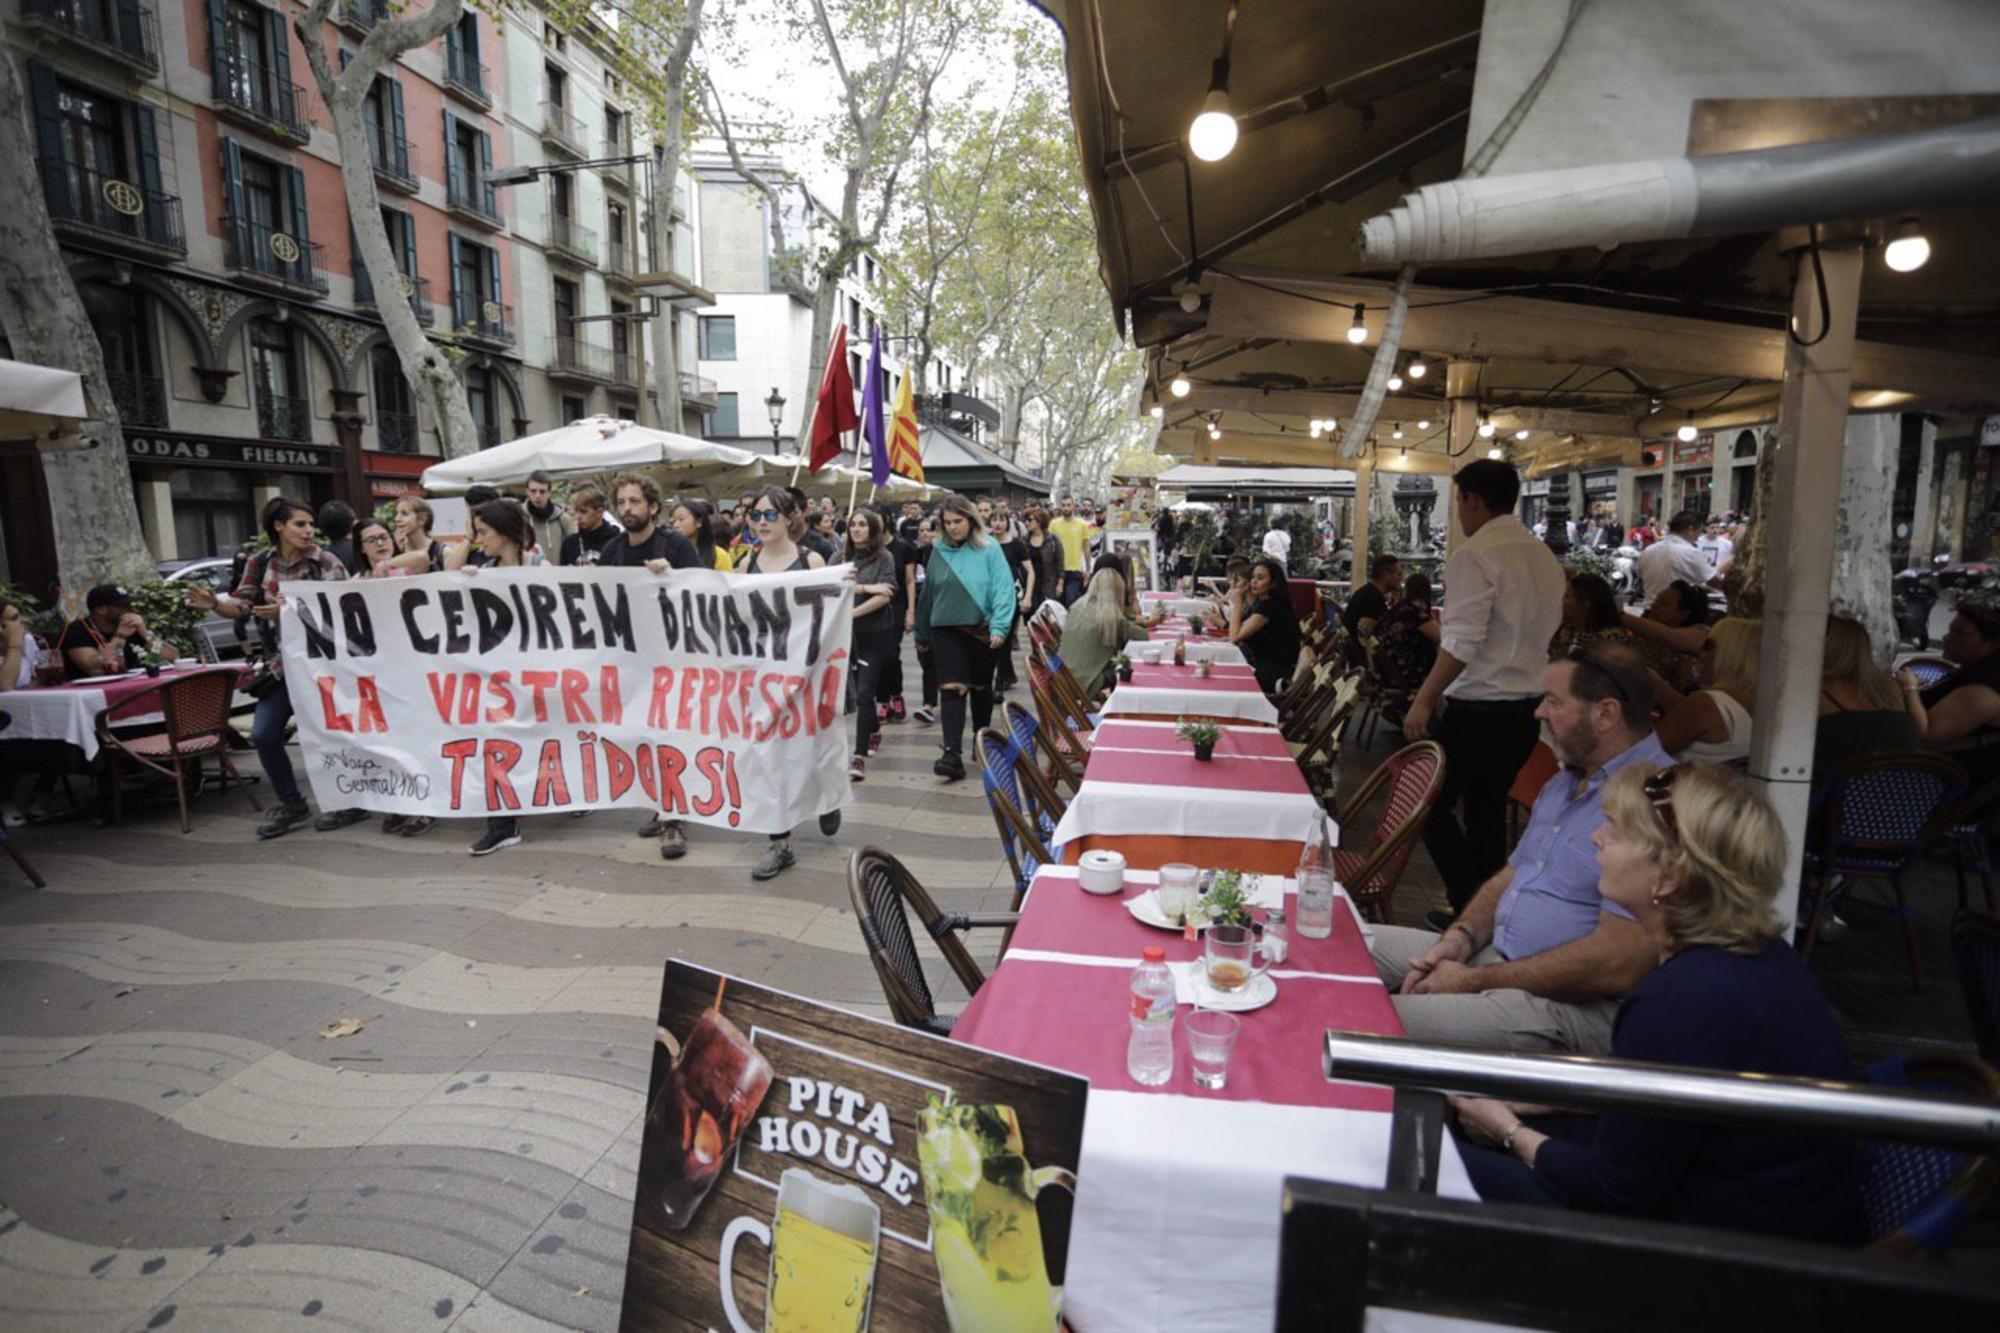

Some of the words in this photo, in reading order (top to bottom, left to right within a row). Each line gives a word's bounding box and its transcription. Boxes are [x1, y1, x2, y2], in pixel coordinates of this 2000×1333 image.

[243, 446, 319, 465] FIESTAS
[297, 592, 377, 660] NO
[400, 583, 637, 655] CEDIREM
[659, 583, 842, 667] DAVANT
[317, 676, 388, 733] LA
[426, 665, 623, 726] VOSTRA
[647, 648, 848, 742] REPRESSIÓ
[442, 729, 742, 828] TRAÏDORS!
[787, 1076, 893, 1146] PITA
[758, 1116, 918, 1206] HOUSE
